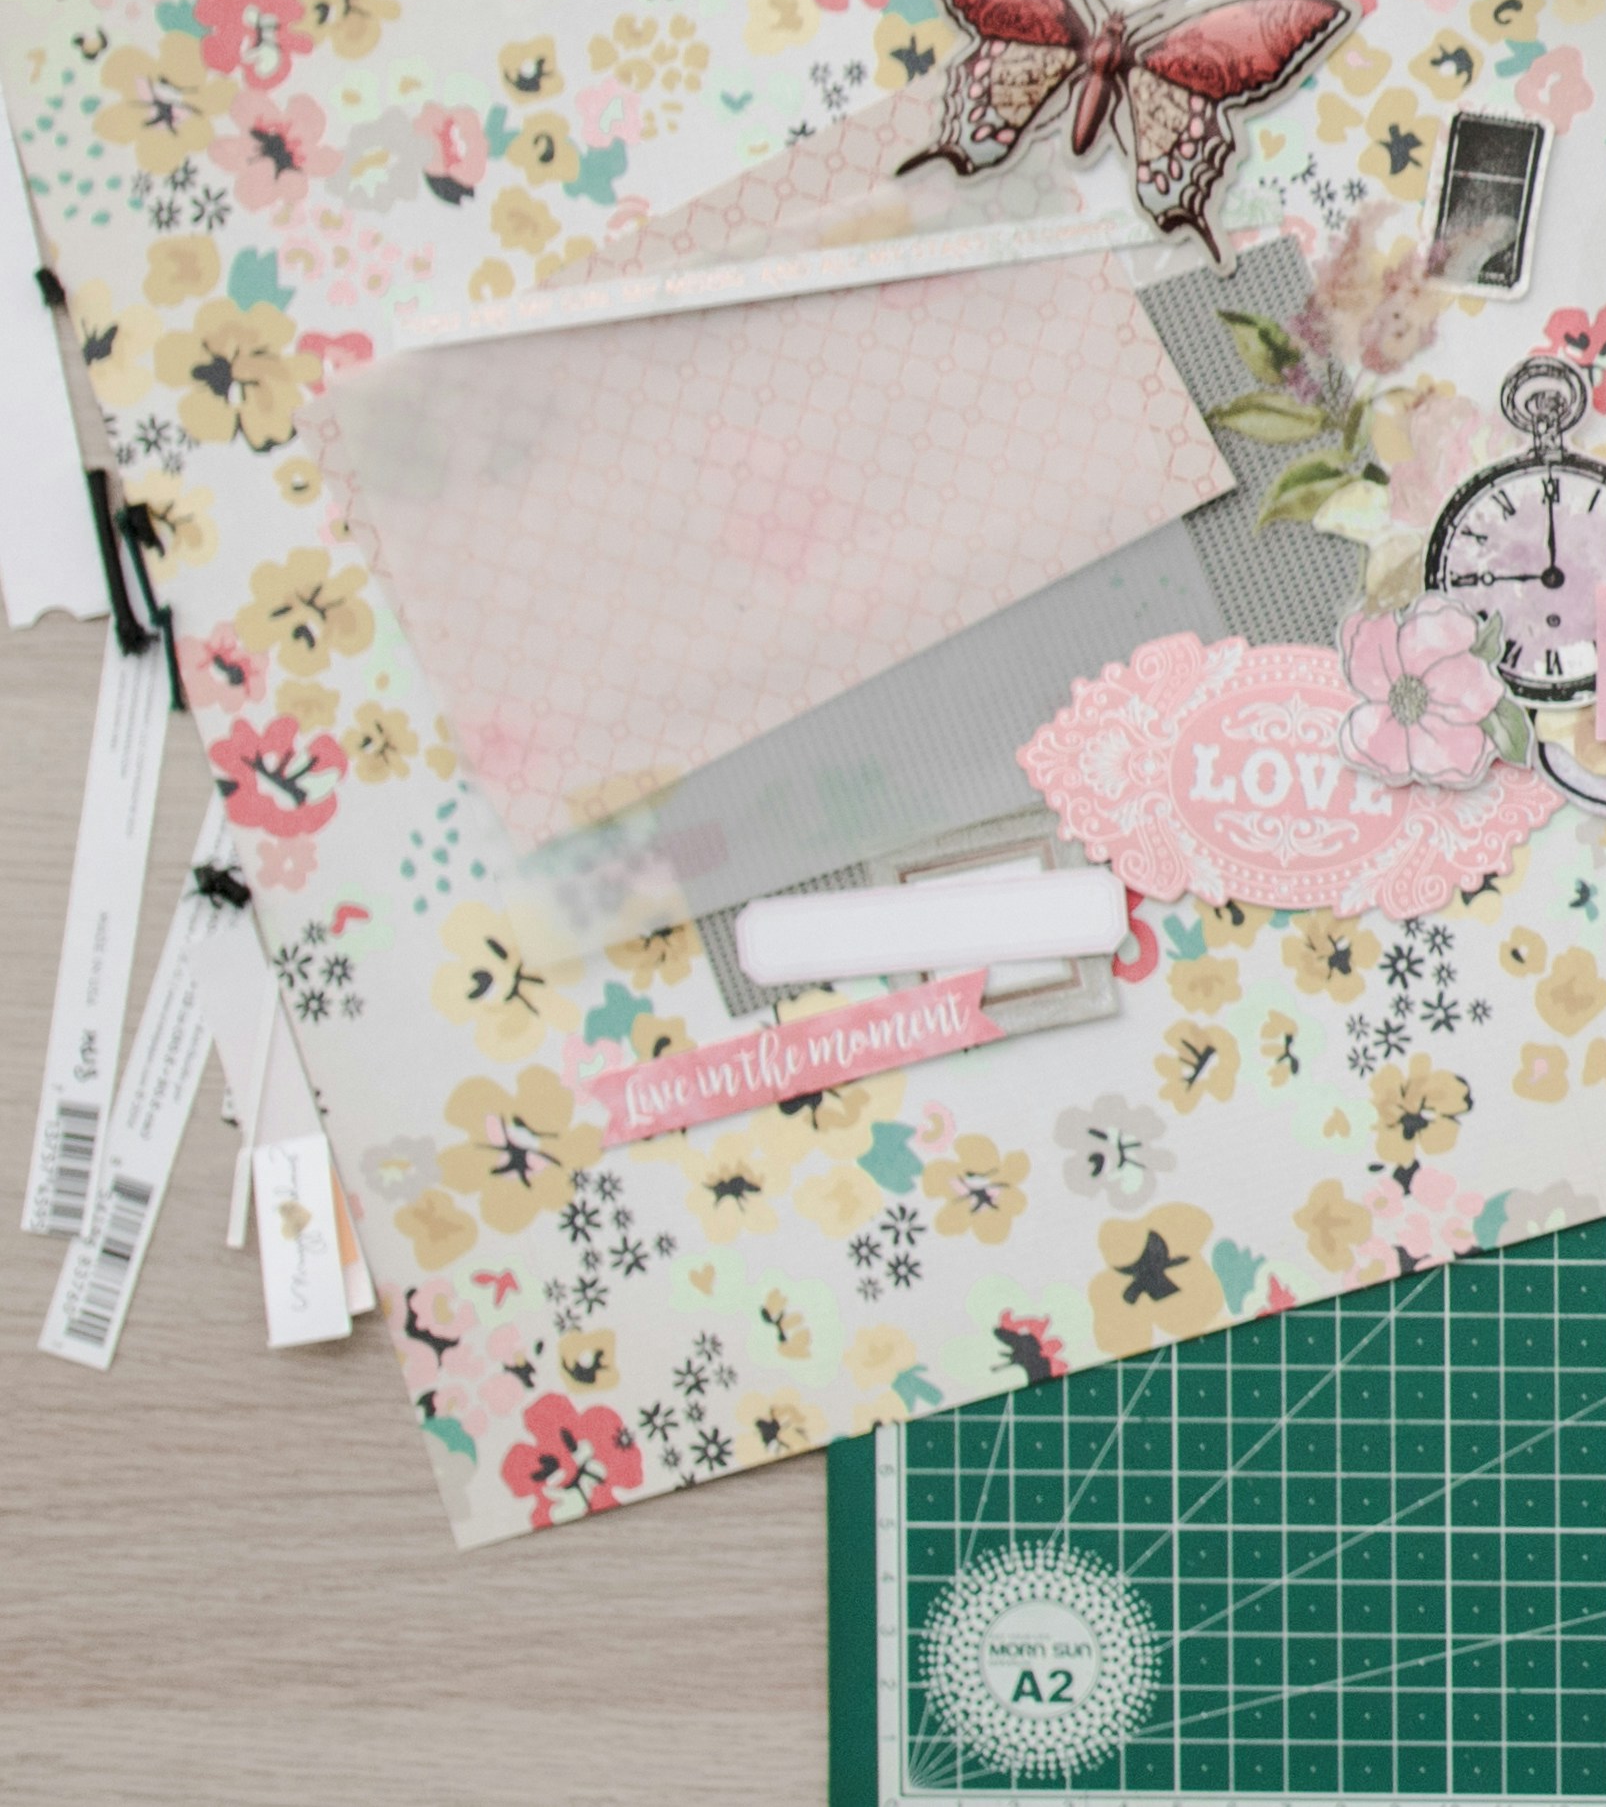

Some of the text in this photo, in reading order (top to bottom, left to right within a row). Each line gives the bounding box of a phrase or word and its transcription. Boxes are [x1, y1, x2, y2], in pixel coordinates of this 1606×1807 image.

[1189, 745, 1393, 816] LOVE
[625, 991, 972, 1127] Live in the moment
[1012, 1669, 1074, 1703] A2
